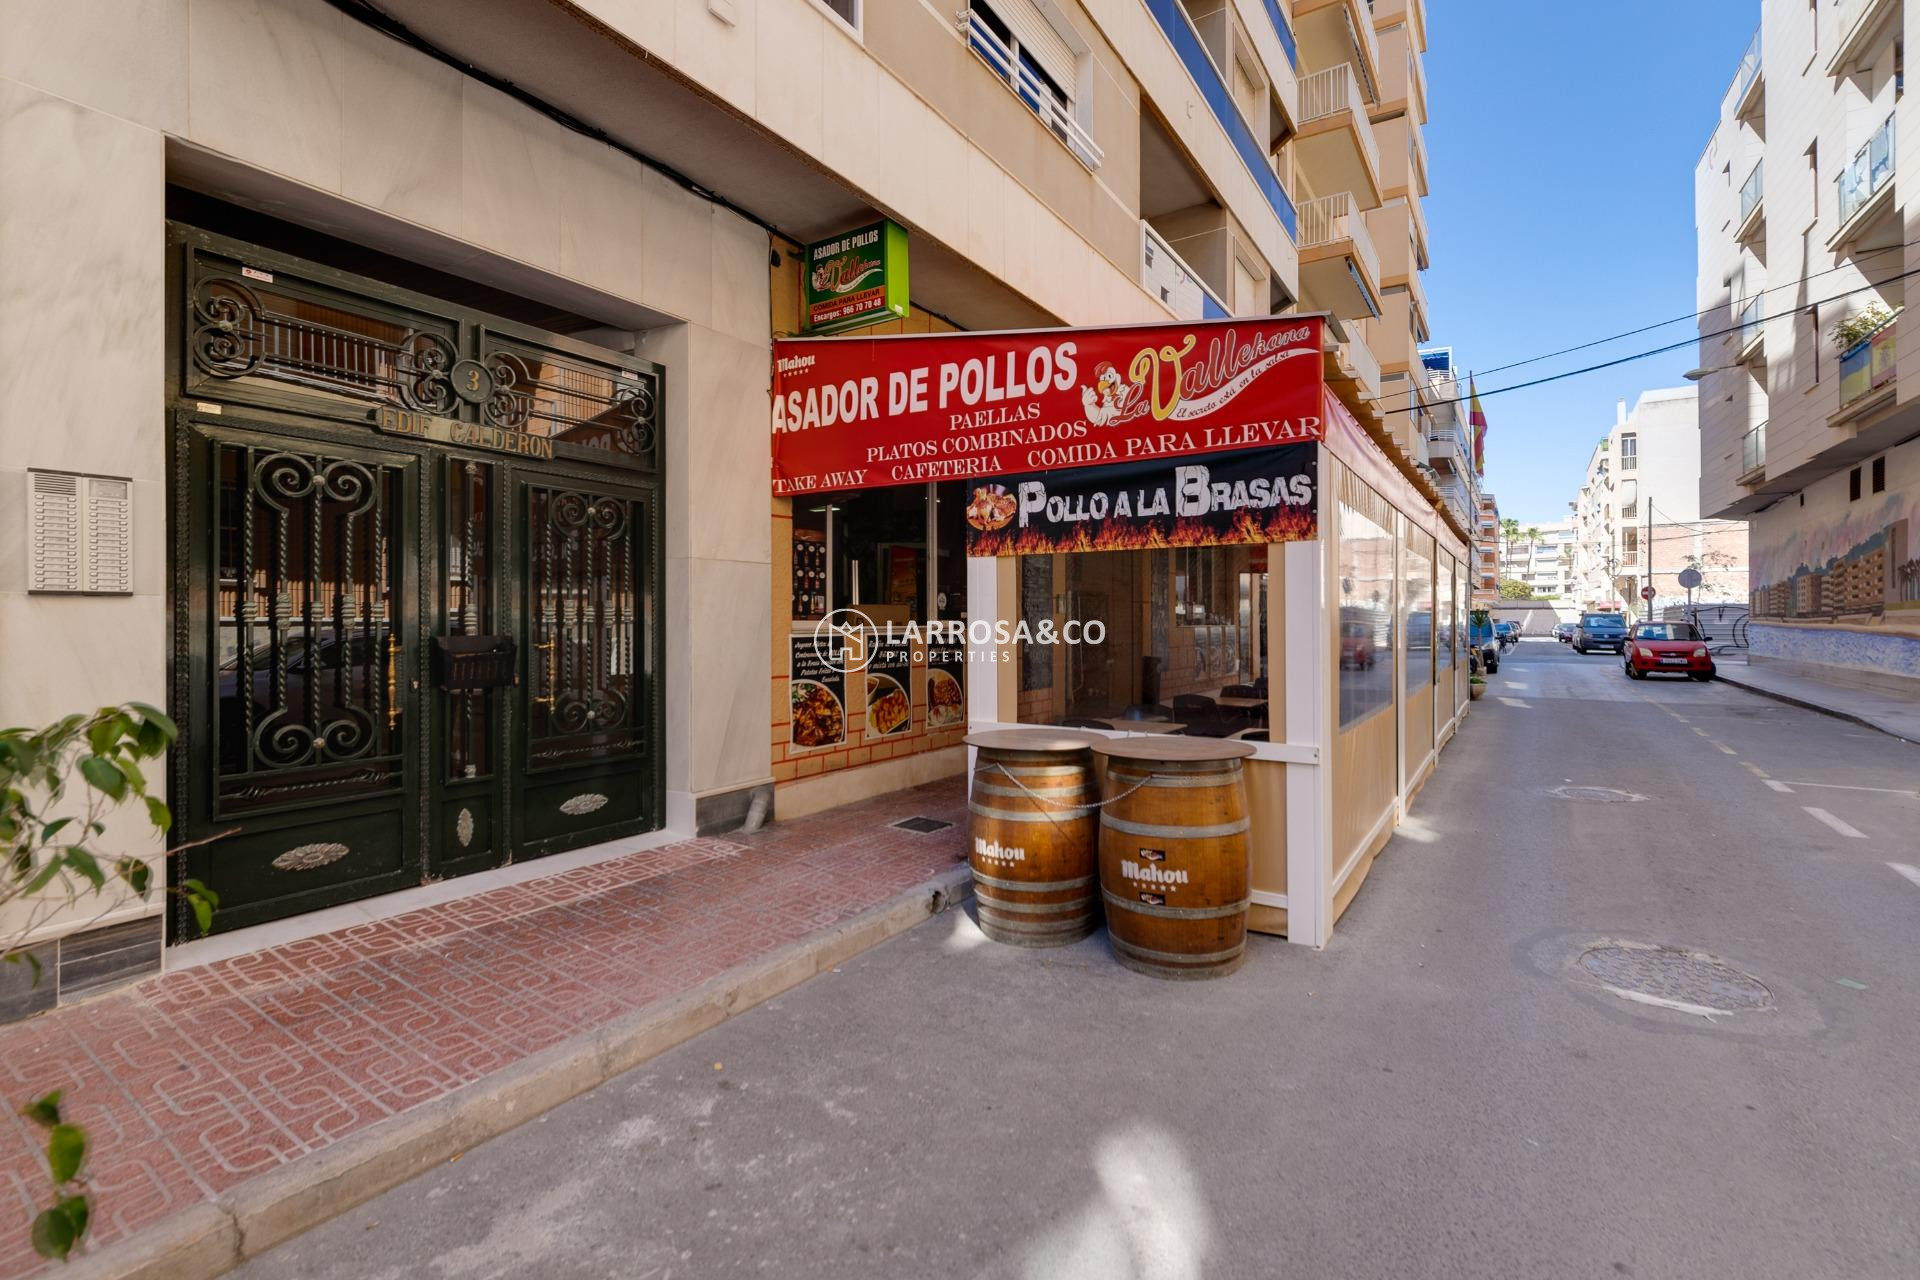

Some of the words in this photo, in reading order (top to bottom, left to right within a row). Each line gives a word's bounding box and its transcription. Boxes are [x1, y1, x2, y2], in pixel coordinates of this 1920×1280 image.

[814, 243, 840, 260] ASADOR
[842, 239, 850, 251] DE
[853, 230, 878, 248] POLLOS
[814, 301, 838, 311] COMIDA
[839, 296, 856, 304] PARA
[857, 289, 880, 299] LLEVAR
[814, 310, 841, 322] Encargos:
[856, 303, 863, 311] 70
[865, 300, 872, 309] 70
[776, 354, 817, 373] Mahou
[1128, 325, 1311, 421] Vallekana
[1239, 377, 1250, 389] en
[1250, 367, 1262, 379] la
[1265, 351, 1290, 369] salsa
[466, 370, 480, 391] 3
[772, 376, 880, 435] ASADOR
[888, 366, 930, 417] DE
[939, 341, 1078, 409] POLLOS
[949, 402, 1041, 431] PAELLAS
[1108, 381, 1151, 427] La
[381, 406, 433, 438] EDIF
[450, 421, 553, 460] CALDERON
[867, 440, 938, 463] PLATOS
[942, 420, 1088, 455] COMBINADOS
[1027, 441, 1118, 468] COMIDA
[1125, 431, 1196, 457] PARA
[1203, 415, 1322, 449] LLEVAR
[772, 474, 817, 494] TAKE
[820, 469, 869, 488] AWAY
[891, 456, 1003, 481] CAFETERIA
[1018, 481, 1109, 528] POLLO
[1113, 491, 1133, 519] A
[1137, 487, 1171, 518] LA
[1175, 465, 1313, 518] BRASAS
[974, 837, 1026, 860] Mahou
[1120, 860, 1189, 884] Mahou
